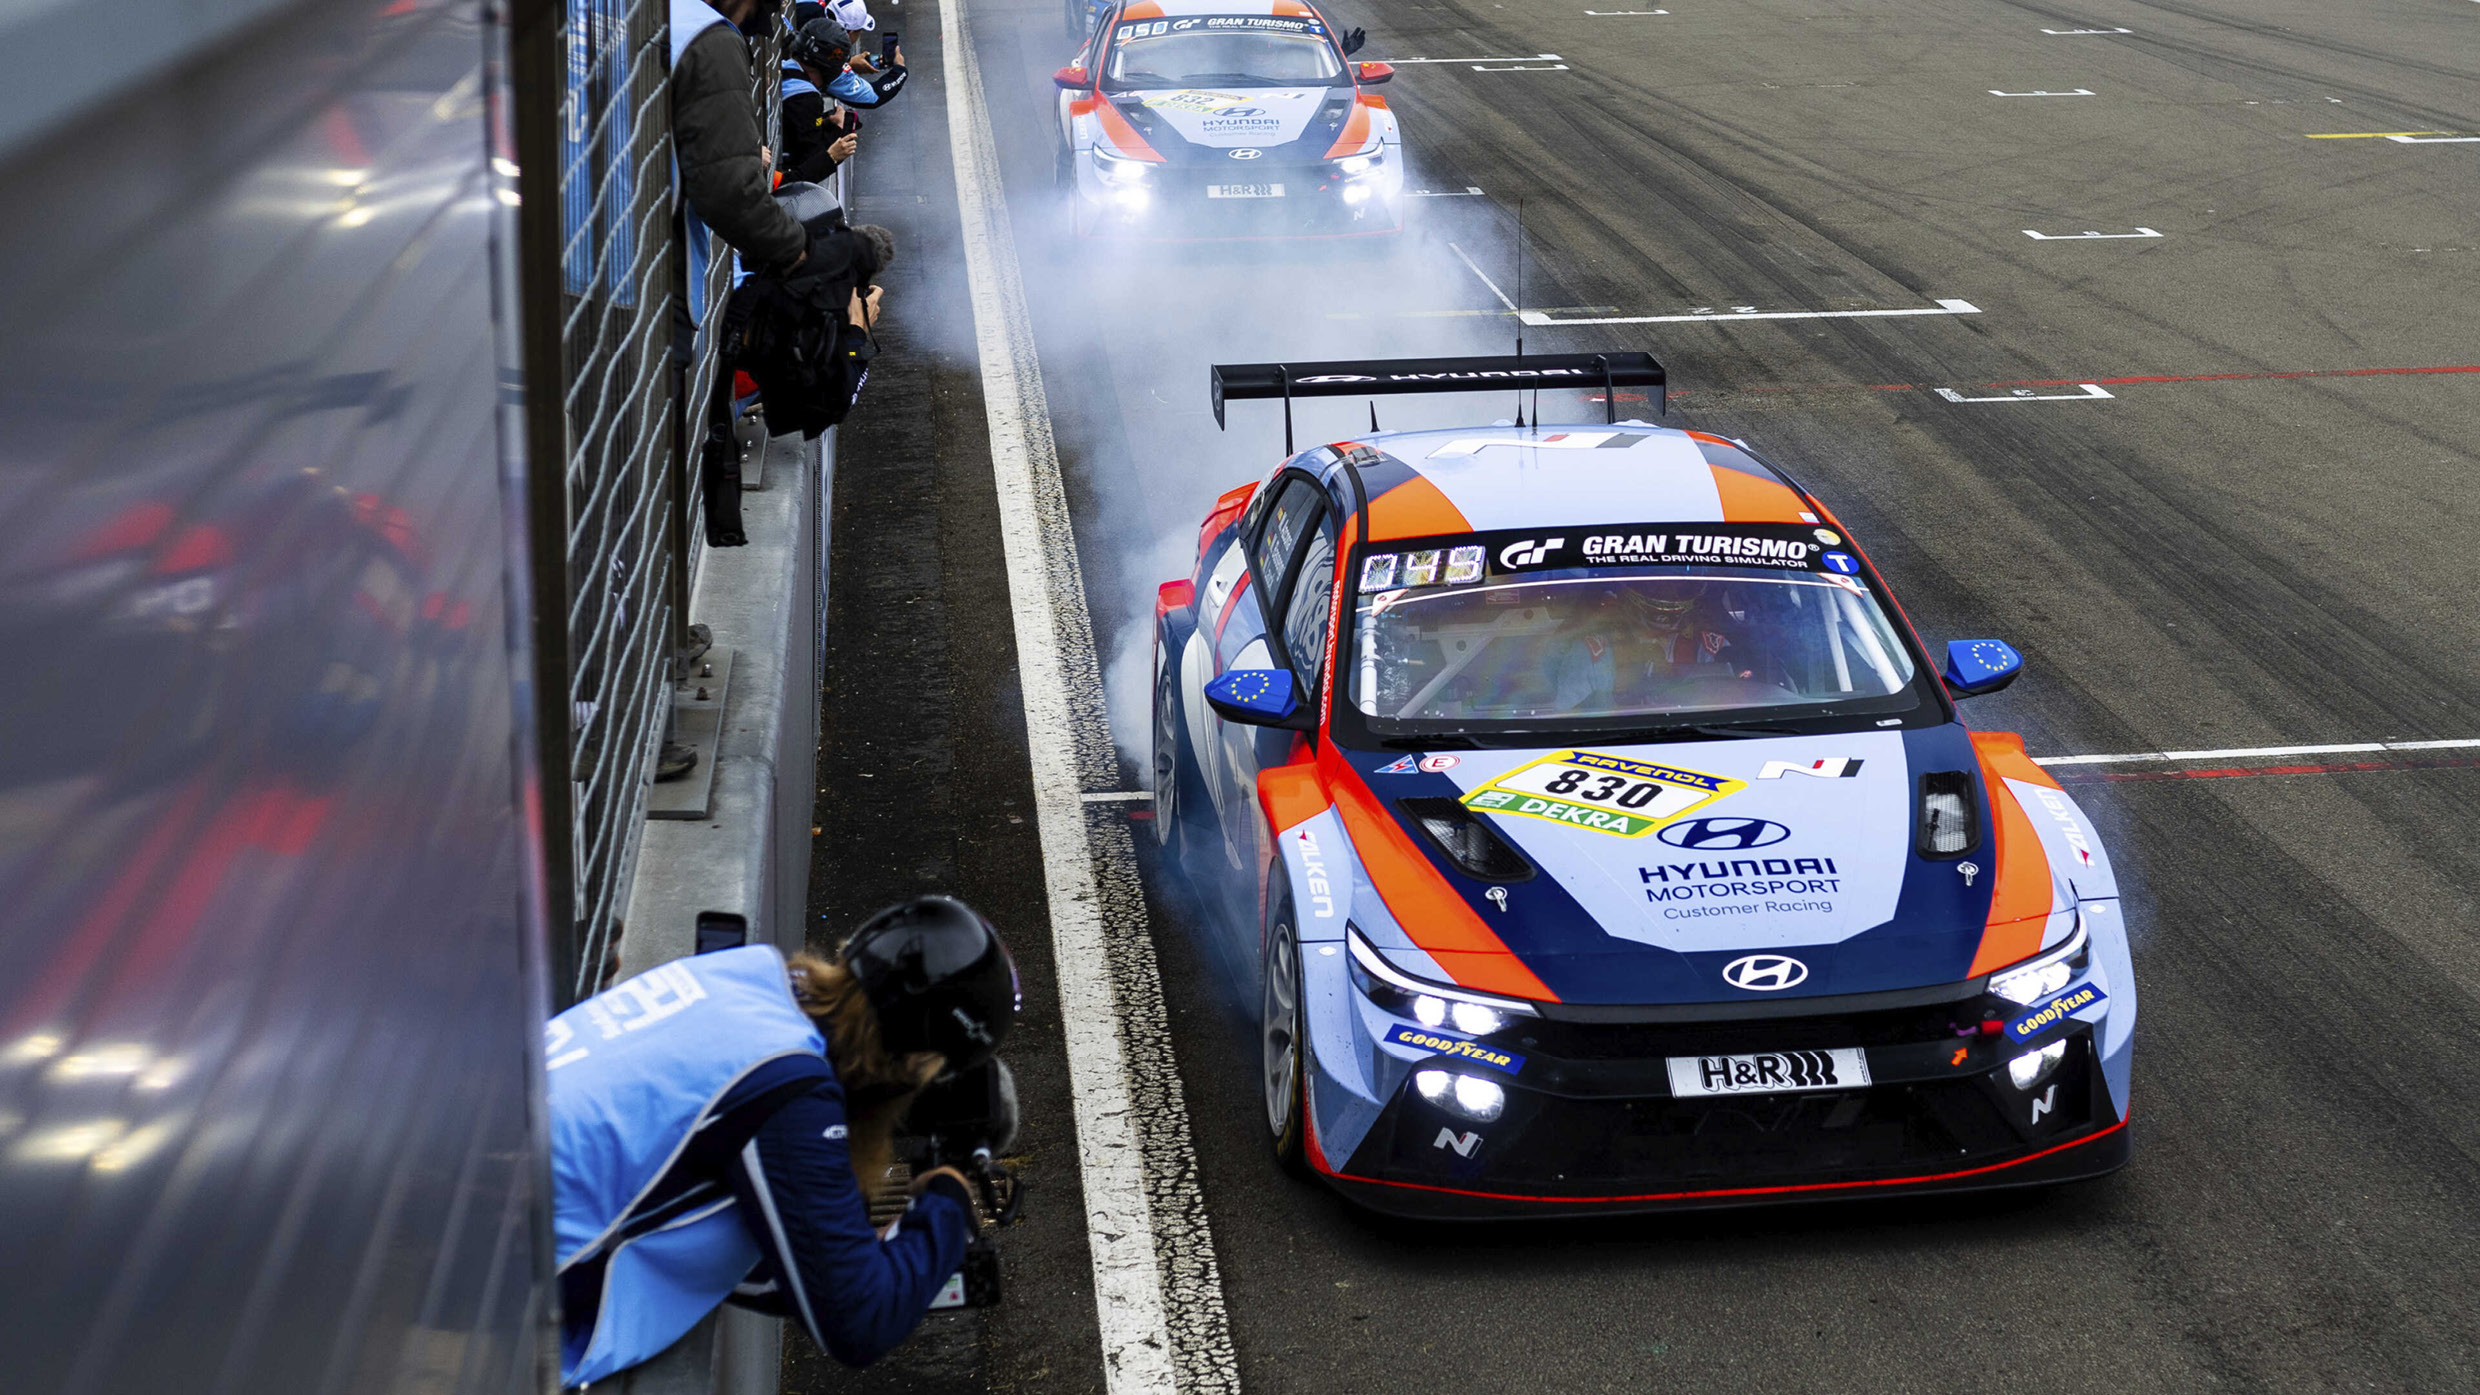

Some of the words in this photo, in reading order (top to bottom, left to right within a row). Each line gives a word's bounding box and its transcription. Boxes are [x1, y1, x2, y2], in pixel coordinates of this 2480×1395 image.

[1207, 18, 1245, 26] GRAN
[1390, 368, 1583, 381] HYUNDAI
[1582, 535, 1667, 555] GRAN
[1585, 555, 1616, 563] THE
[1619, 554, 1659, 562] REAL
[1661, 554, 1722, 563] DRIVING
[1724, 556, 1809, 569] SIMULATOR
[1826, 554, 1850, 572] T
[1431, 758, 1449, 768] E
[1577, 754, 1711, 788] RAVENOL
[1544, 769, 1664, 809] 830
[1518, 798, 1630, 834] DEKRA
[1296, 829, 1334, 919] FALKEN
[1638, 857, 1838, 884] HYUNDAI
[1645, 878, 1842, 903] MOTORSPORT
[1663, 902, 1760, 921] Customer
[1765, 898, 1834, 916] Racing
[2016, 989, 2096, 1037] GOODYEAR
[1398, 1031, 1512, 1068] GOODYEAR
[1700, 1054, 1787, 1090] H&R
